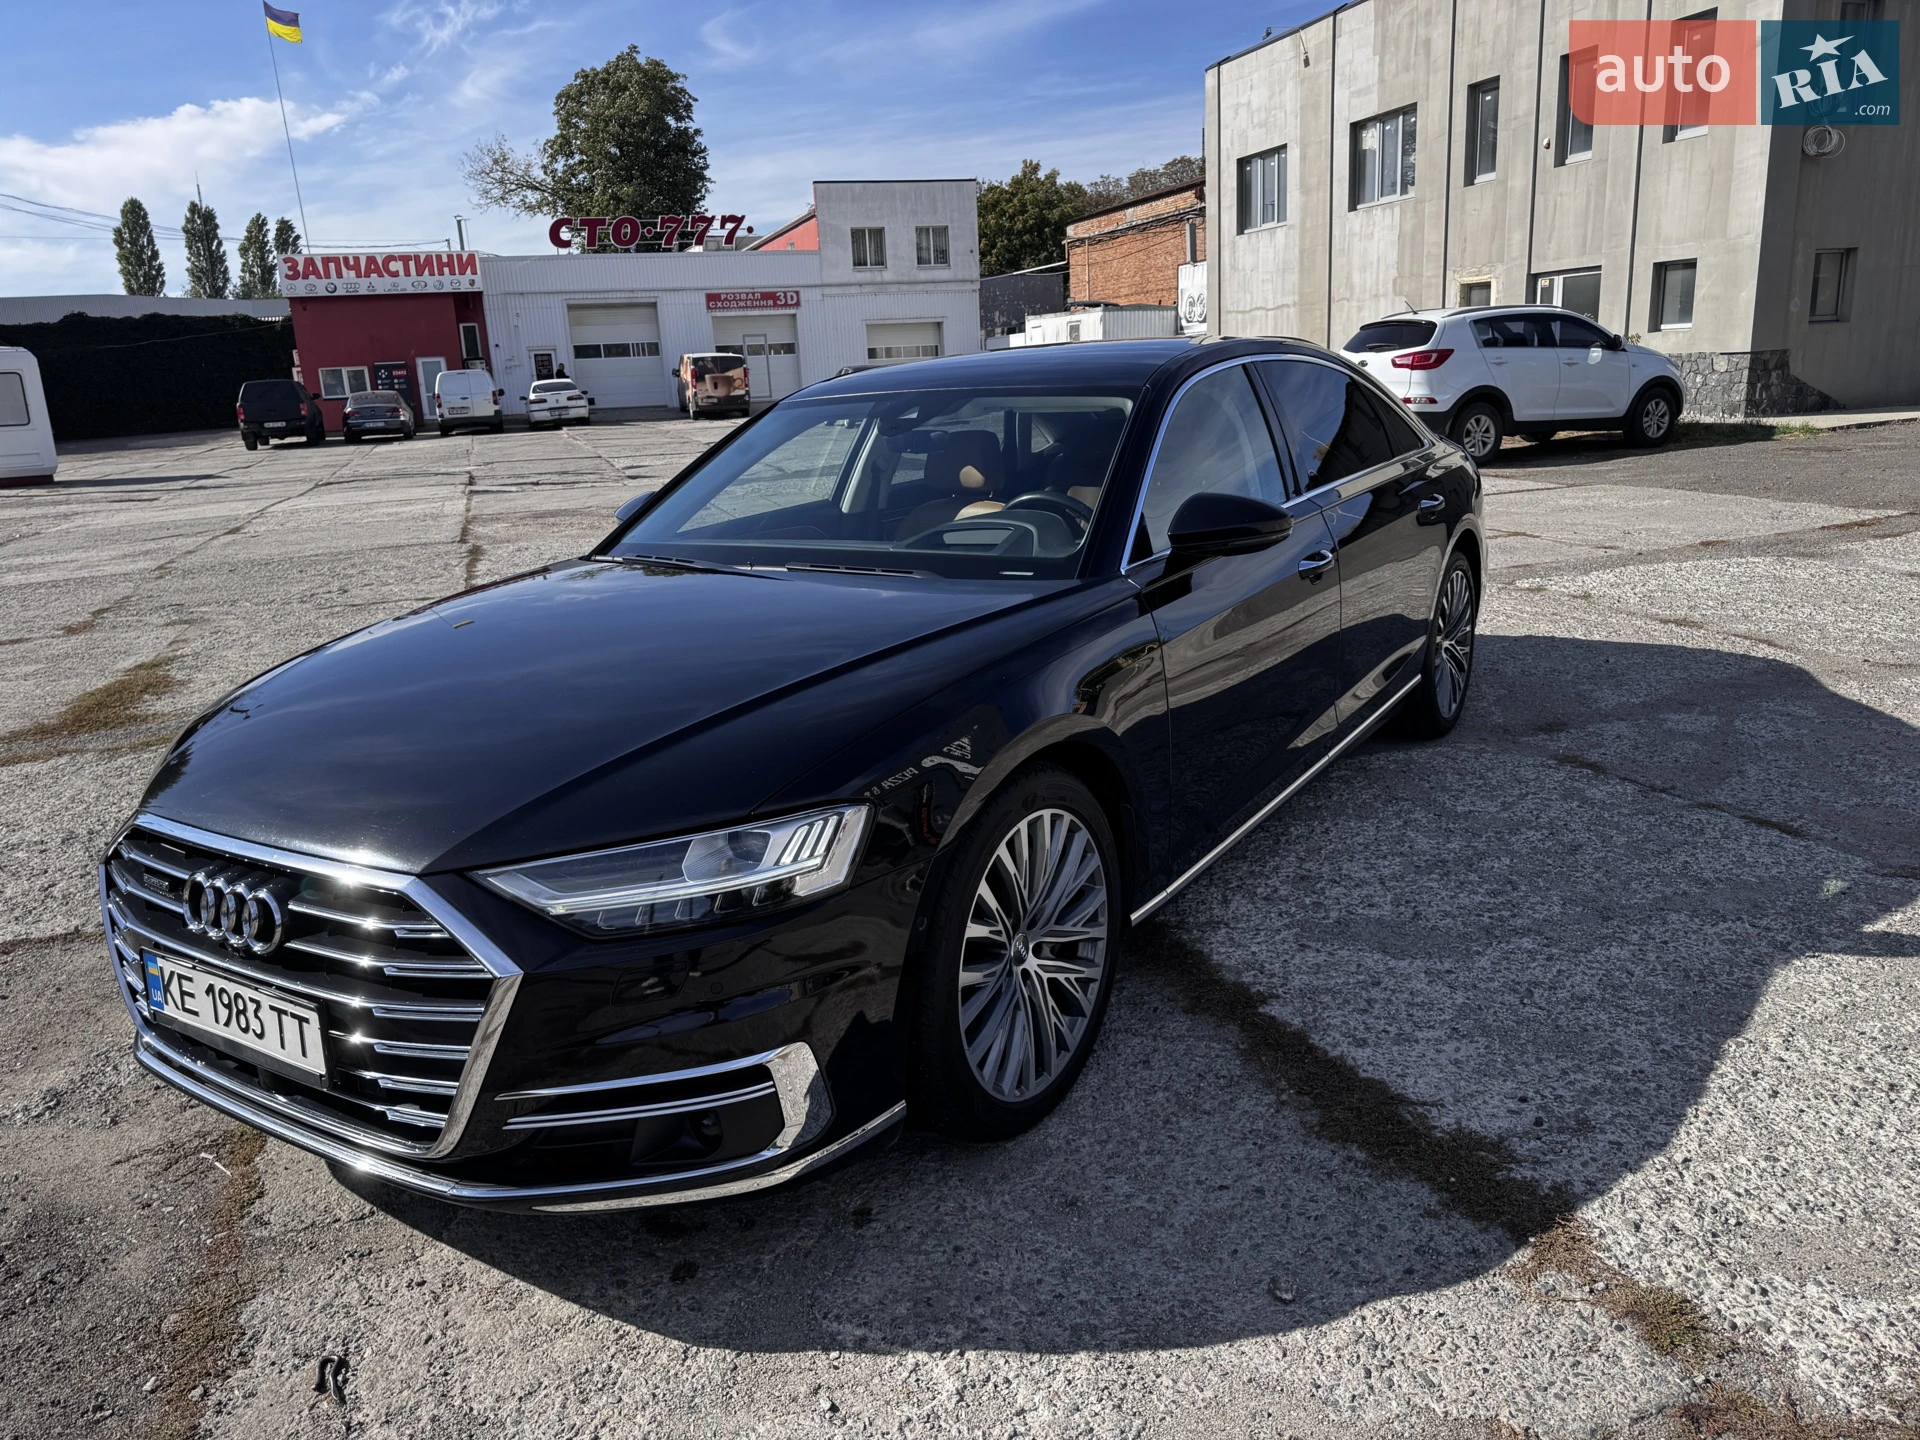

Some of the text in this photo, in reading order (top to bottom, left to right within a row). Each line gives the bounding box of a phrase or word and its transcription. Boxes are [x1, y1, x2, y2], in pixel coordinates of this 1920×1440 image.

[282, 253, 479, 281] ЗАПЧАСТИНИ
[709, 299, 774, 308] СХОДЖЕННЯ
[720, 293, 761, 301] РОЗВАЛ
[775, 291, 798, 305] 3D
[151, 987, 163, 1003] UA
[158, 964, 311, 1059] KE 1983 TT
